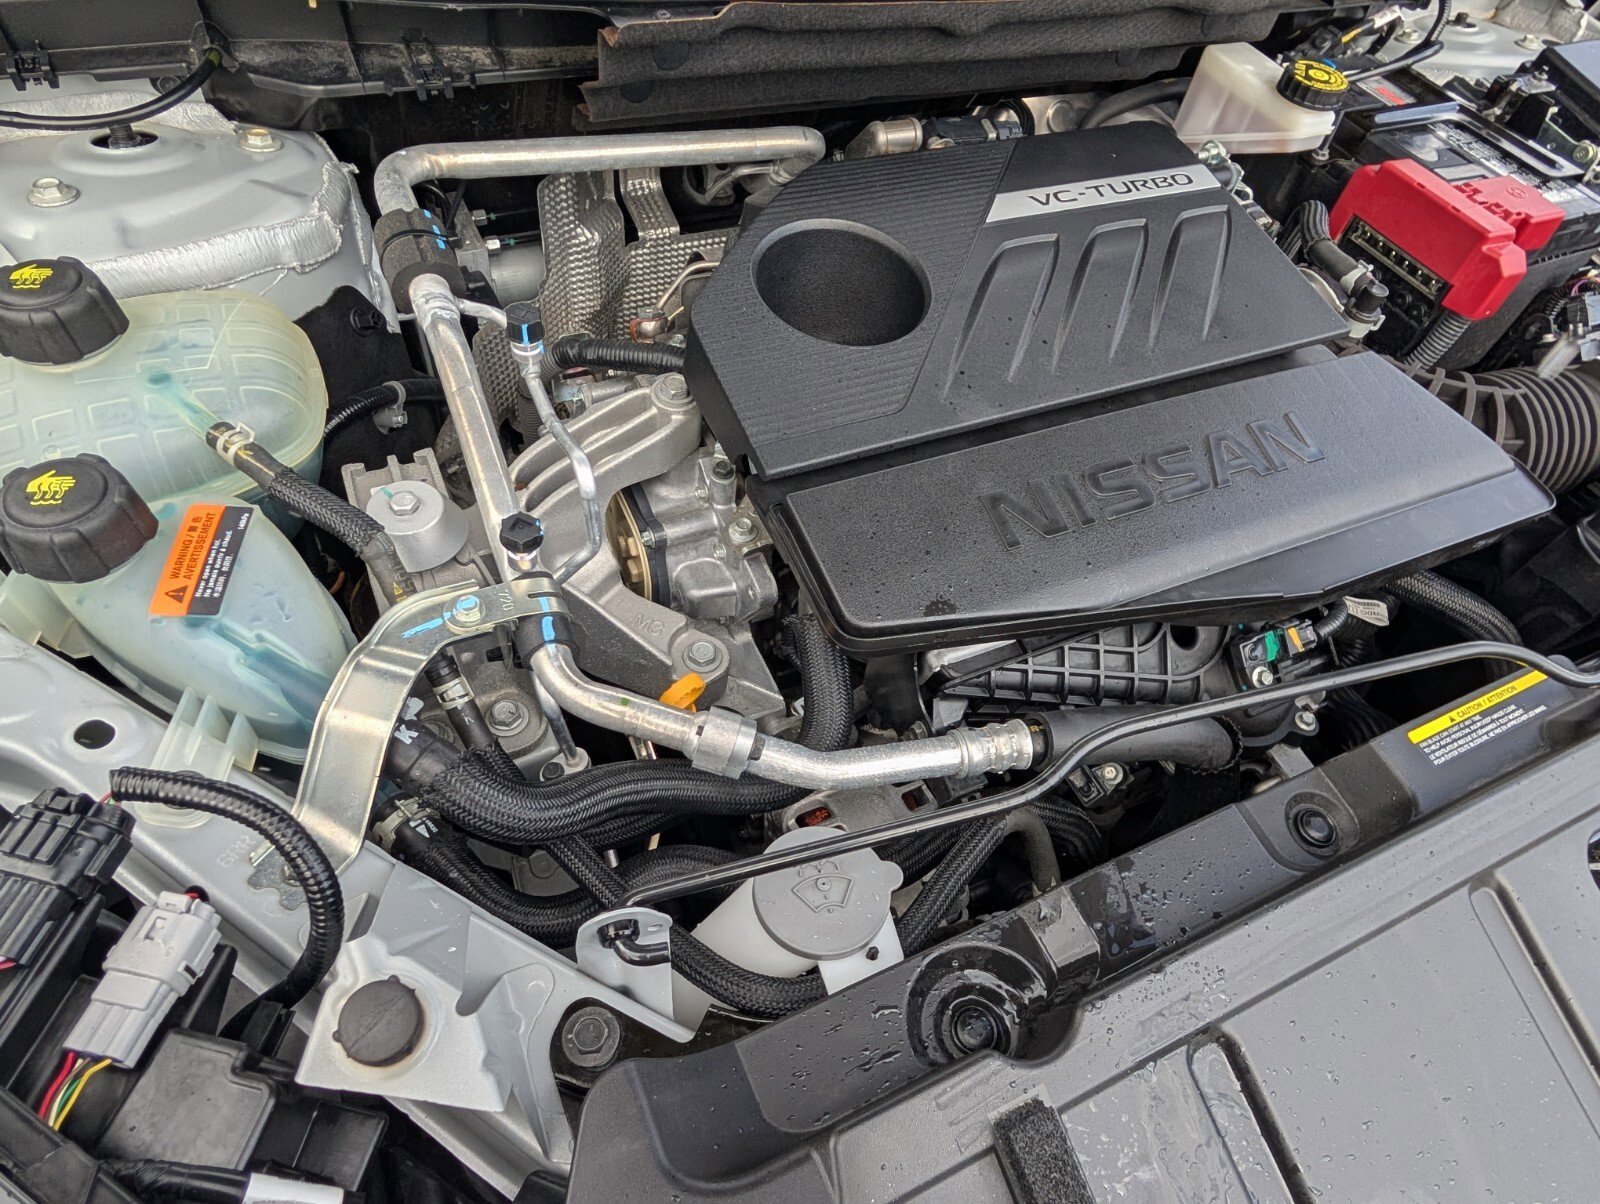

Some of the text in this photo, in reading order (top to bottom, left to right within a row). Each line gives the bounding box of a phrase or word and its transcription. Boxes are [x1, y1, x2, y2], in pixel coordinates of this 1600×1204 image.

[1027, 173, 1194, 206] VC-TURBO
[979, 411, 1326, 551] NISSAN
[170, 539, 193, 579] WARNING
[183, 512, 216, 580] AVERTISSEMENT
[1457, 703, 1482, 718] CAUTION
[1487, 686, 1517, 703] ATTENTION
